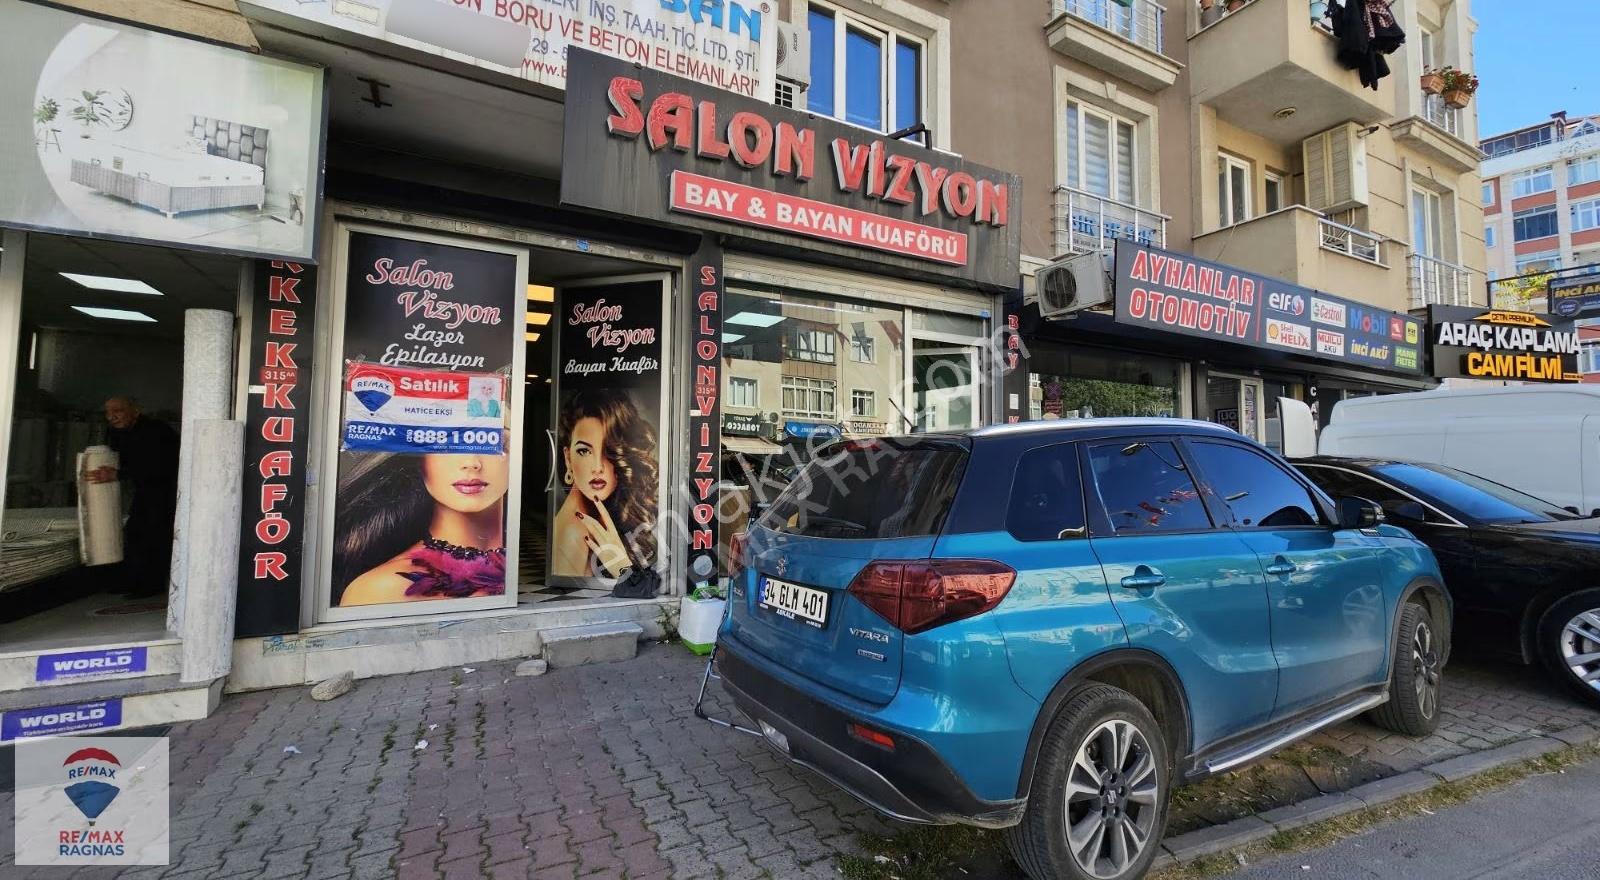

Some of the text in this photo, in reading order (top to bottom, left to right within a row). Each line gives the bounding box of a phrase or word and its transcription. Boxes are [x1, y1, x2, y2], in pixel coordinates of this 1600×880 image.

[495, 0, 553, 32] BORU
[559, 15, 583, 42] VE
[589, 26, 649, 65] BETON
[623, 10, 669, 42] TAAH.
[703, 38, 731, 64] LTD.
[607, 75, 1008, 228] SALON VİZYON
[684, 181, 958, 258] BAY & BAYAN KUAFÖRÜ
[366, 257, 453, 291] Salon
[1130, 250, 1255, 307] AYHANLAR
[397, 290, 501, 329] Vizyon
[569, 299, 622, 325] Salon
[1129, 286, 1251, 339] OTOMOTİV
[1268, 292, 1292, 311] elf
[1350, 307, 1386, 336] Mobil
[405, 323, 465, 346] Lazer
[587, 323, 656, 352] Vizyon
[1007, 314, 1019, 370] BAY
[1281, 333, 1309, 347] HELIX
[1438, 321, 1493, 351] ARAÇ
[1495, 324, 1582, 355] KAPLAMA
[380, 343, 485, 370] Epilasyon
[565, 355, 658, 377] Bayan Kuaför
[1468, 352, 1562, 380] CAM FİLMİ
[357, 377, 460, 393] RE/MAX Satılık
[692, 266, 718, 549] SALON VİZYON
[348, 425, 396, 436] RE/MAX
[413, 430, 447, 443] 888
[254, 383, 297, 580] KUAFÖR
[764, 580, 824, 619] 34 GLM 401
[849, 627, 889, 643] VITARA
[53, 655, 132, 672] WORLD
[20, 708, 106, 728] WORLD
